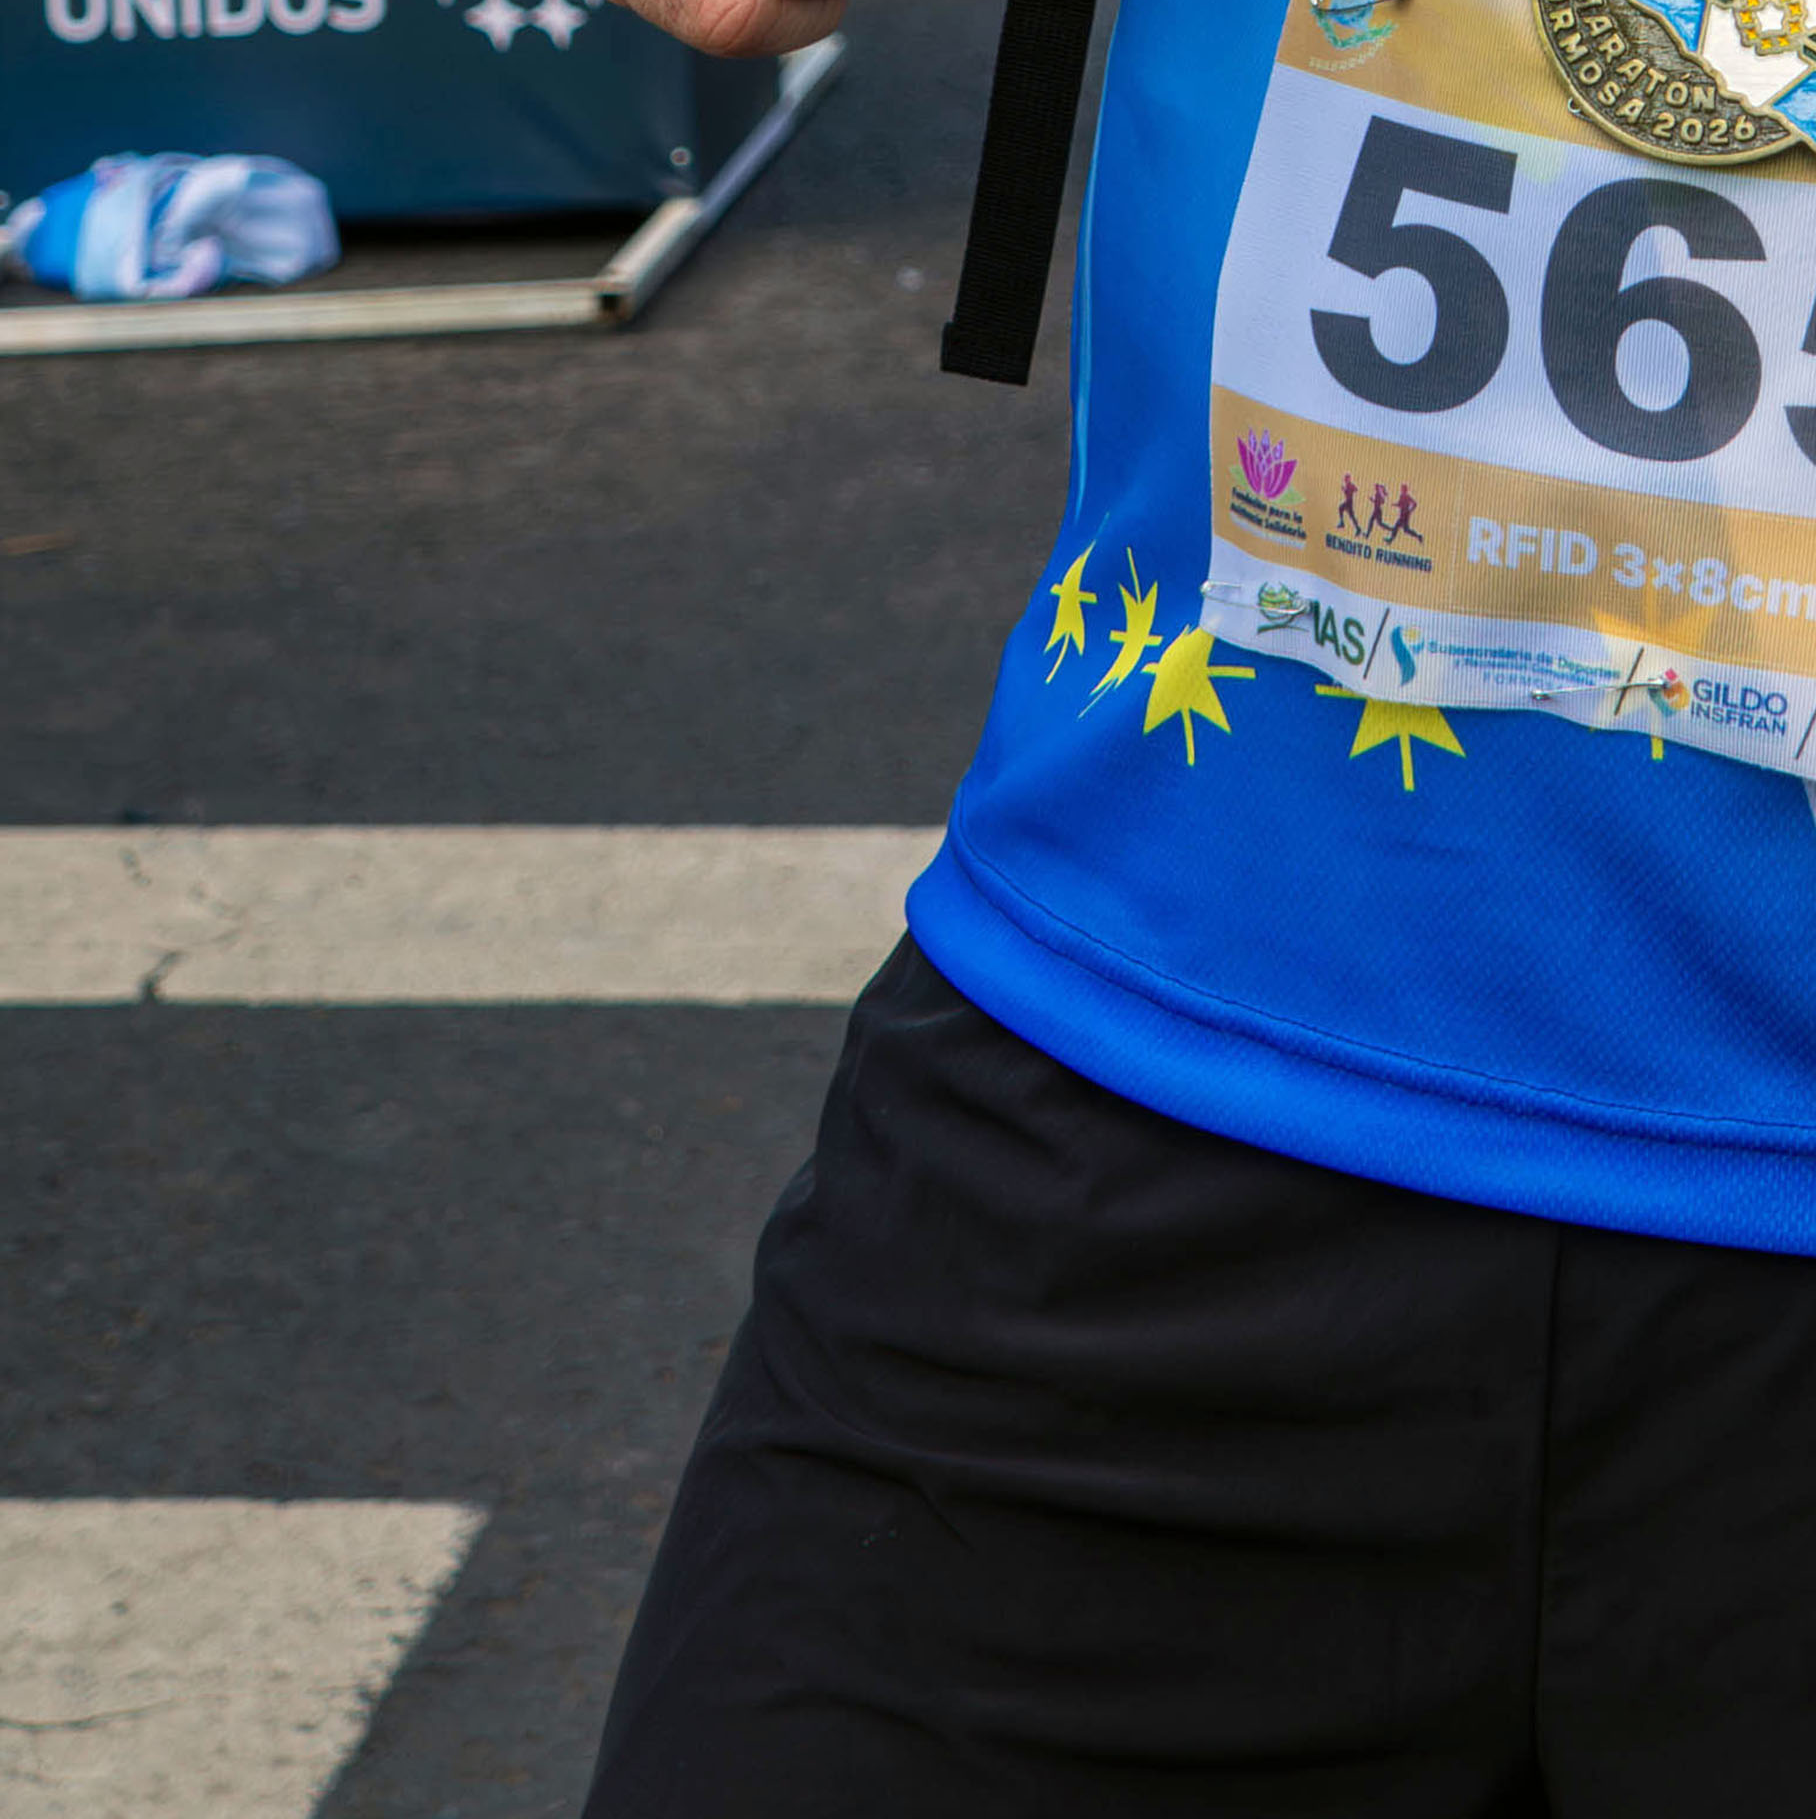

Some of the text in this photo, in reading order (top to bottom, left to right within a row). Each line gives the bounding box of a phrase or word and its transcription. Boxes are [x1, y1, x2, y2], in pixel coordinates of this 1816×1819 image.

[1652, 111, 1757, 145] 2026
[1325, 532, 1432, 573] BENDITO RUNNING
[1466, 516, 1598, 577] RFID
[1692, 678, 1789, 717] GILDO
[1690, 705, 1787, 737] INSFRAN
